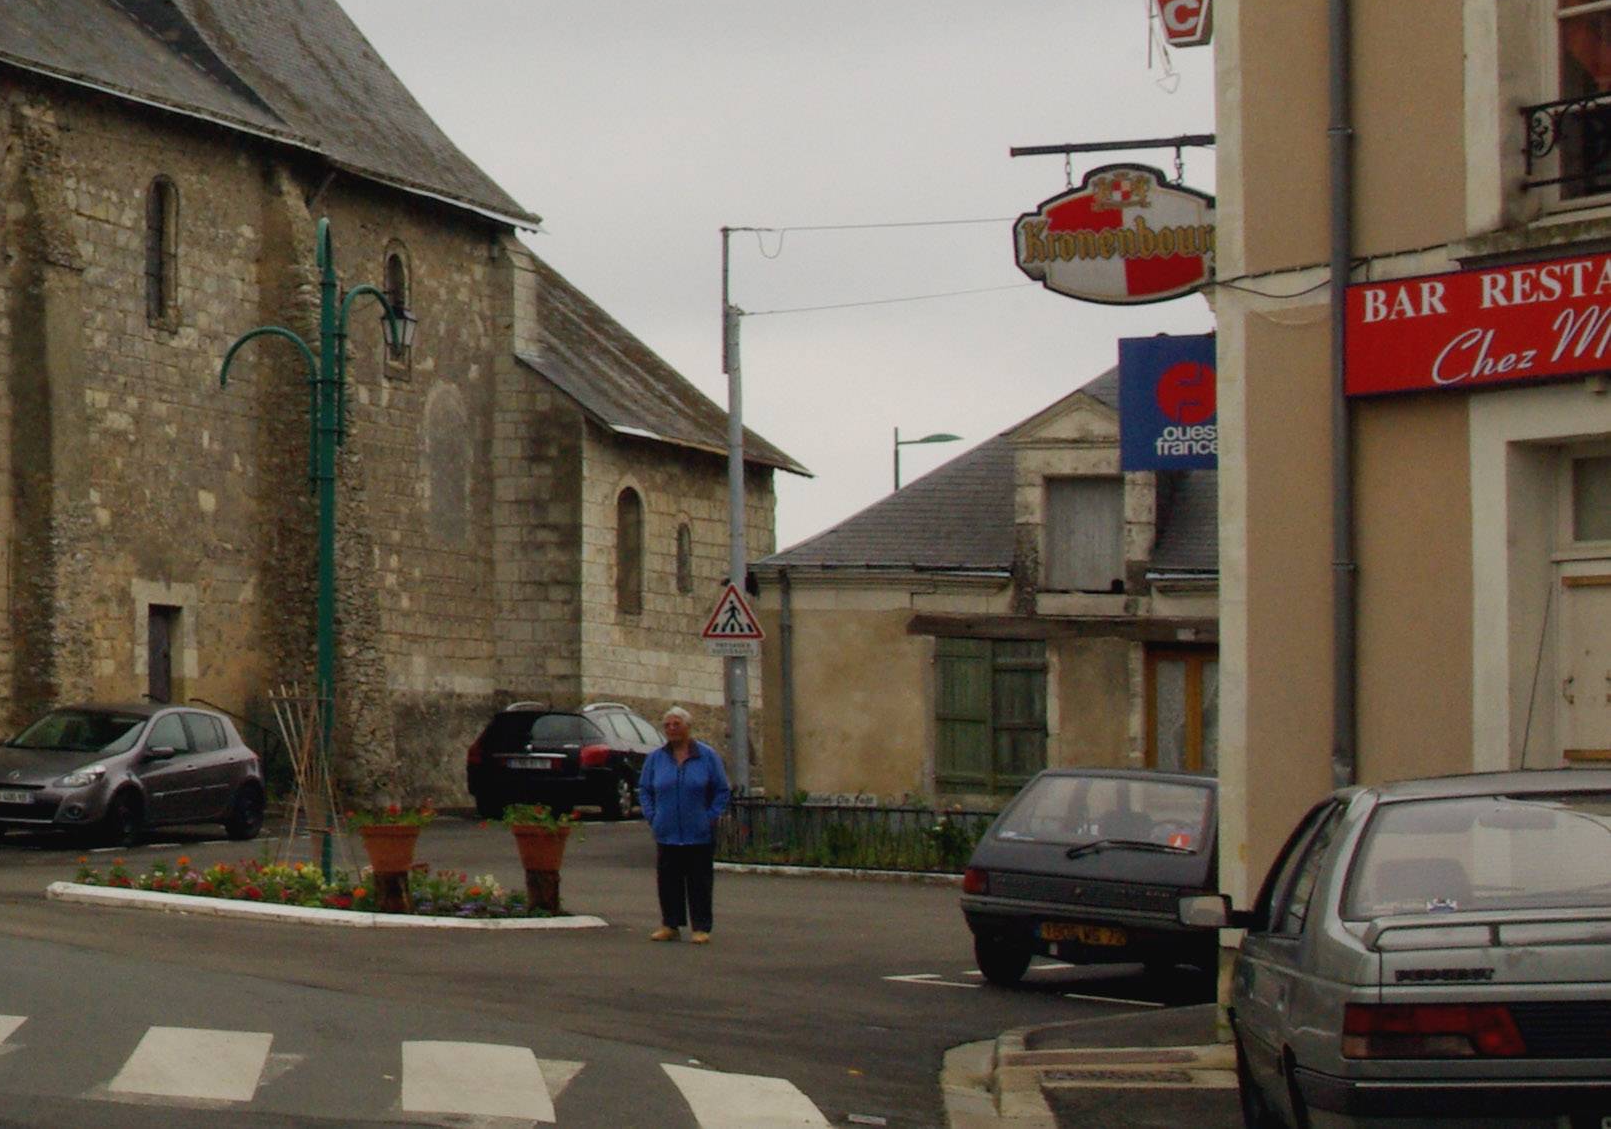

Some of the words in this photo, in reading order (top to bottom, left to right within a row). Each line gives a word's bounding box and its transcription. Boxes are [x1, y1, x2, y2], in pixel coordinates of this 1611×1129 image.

[1363, 281, 1447, 323] BAR
[1479, 258, 1611, 308] RESTA
[1432, 327, 1537, 384] Chez
[1163, 425, 1217, 440] oues
